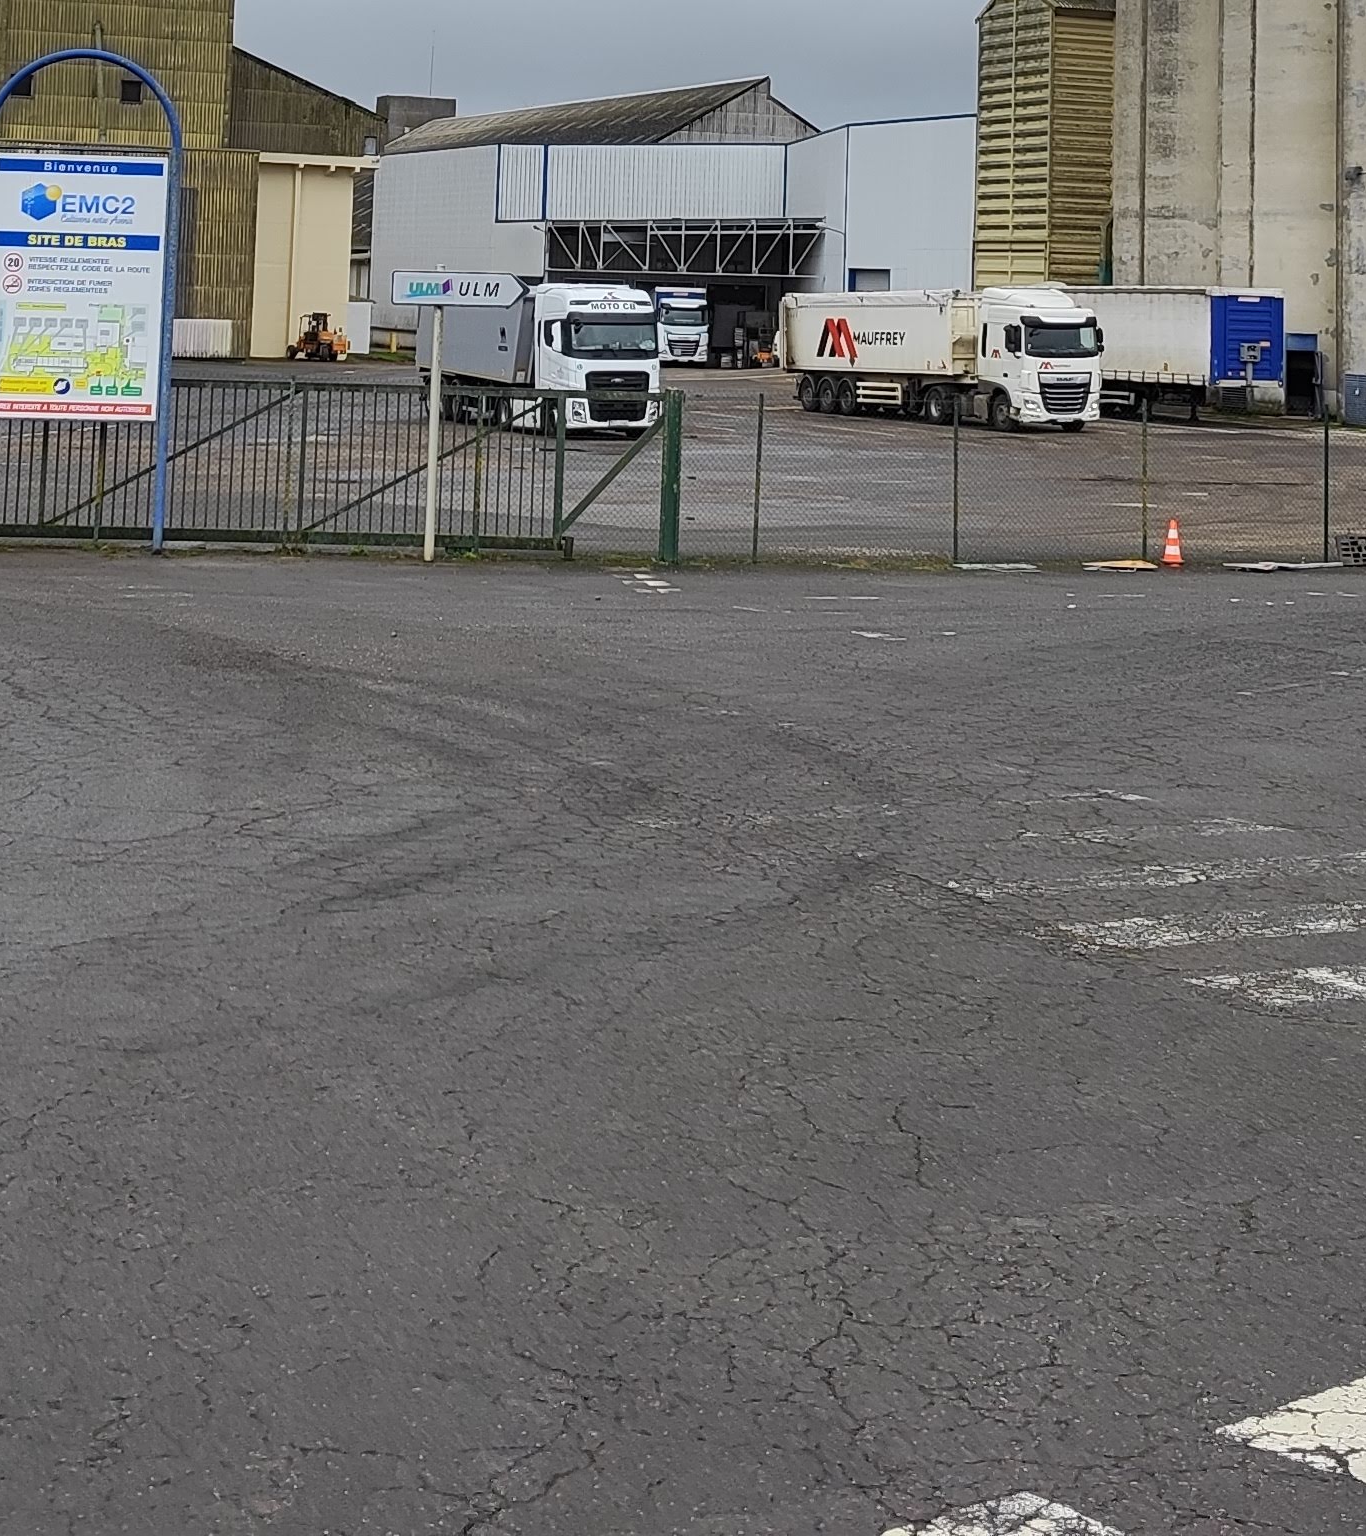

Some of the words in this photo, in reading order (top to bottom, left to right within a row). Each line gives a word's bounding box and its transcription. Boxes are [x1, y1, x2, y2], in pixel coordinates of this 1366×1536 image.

[43, 161, 118, 173] Bienvenue
[61, 194, 135, 215] EMC2
[27, 234, 61, 246] SITE
[64, 235, 84, 246] DE
[87, 236, 127, 248] BRAS
[7, 257, 20, 268] 20
[408, 282, 440, 294] ULM
[458, 281, 500, 297] ULM
[590, 302, 620, 310] MOTO
[852, 331, 906, 346] MAUFFREY
